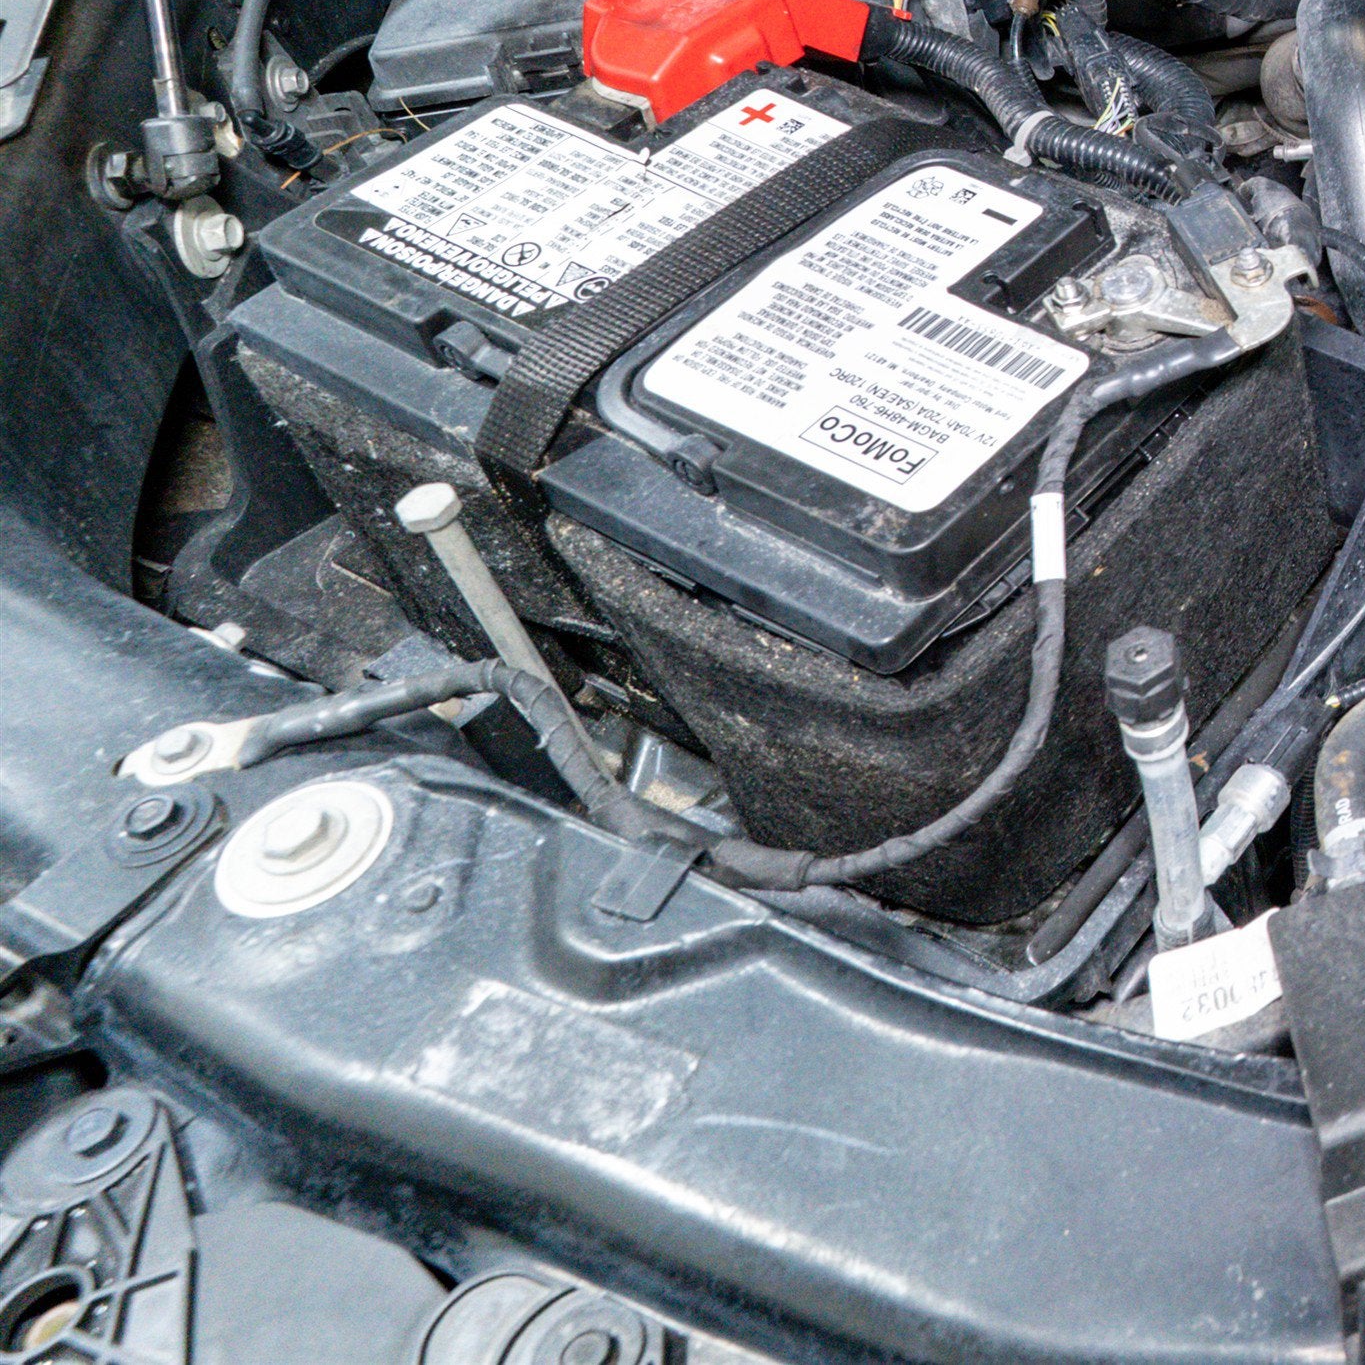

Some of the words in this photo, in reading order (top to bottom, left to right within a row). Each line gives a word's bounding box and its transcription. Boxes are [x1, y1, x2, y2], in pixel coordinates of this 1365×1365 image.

[372, 235, 516, 308] DANGER/POISON
[397, 225, 551, 301] PELIGRO/VENENO
[886, 362, 898, 370] MI
[829, 367, 865, 387] 120RC
[866, 383, 918, 410] (SAE/EN)
[972, 400, 993, 413] Motor
[850, 395, 948, 443] BAGM-48H6-760
[916, 406, 944, 424] 720A
[994, 410, 1010, 420] Ford
[946, 419, 974, 437] 70Ah
[820, 417, 924, 473] FoMoCo
[974, 433, 996, 446] 12V
[1335, 797, 1353, 825] RAD
